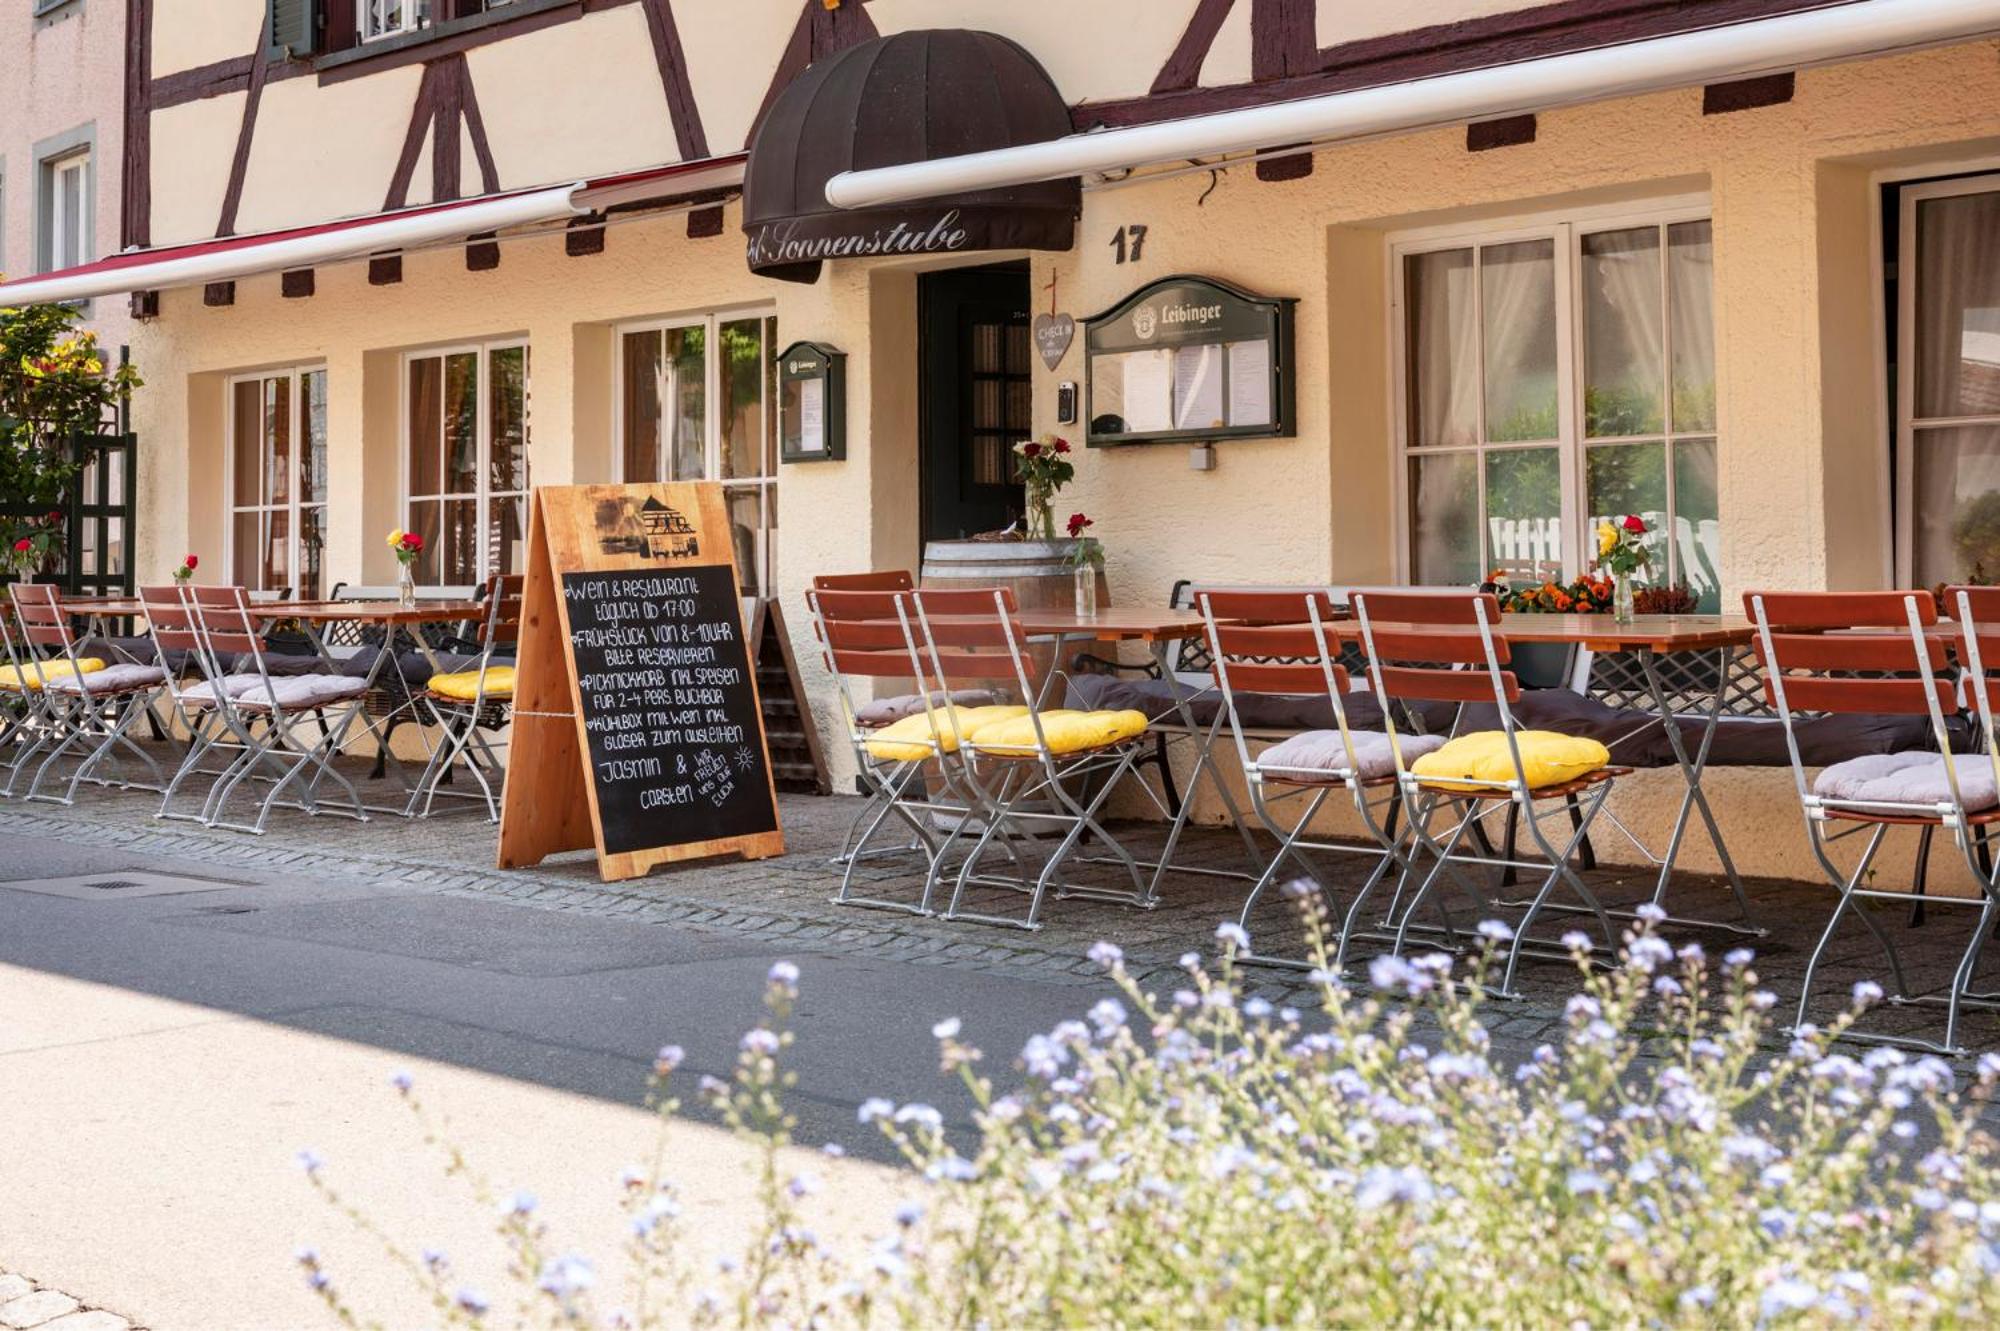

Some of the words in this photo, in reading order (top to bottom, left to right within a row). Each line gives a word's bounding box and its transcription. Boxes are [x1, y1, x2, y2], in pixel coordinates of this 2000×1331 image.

[768, 209, 967, 262] Sonnenstube
[1109, 225, 1148, 265] 17
[1162, 304, 1221, 324] Leibinger
[612, 580, 621, 597] &
[676, 754, 687, 774] &
